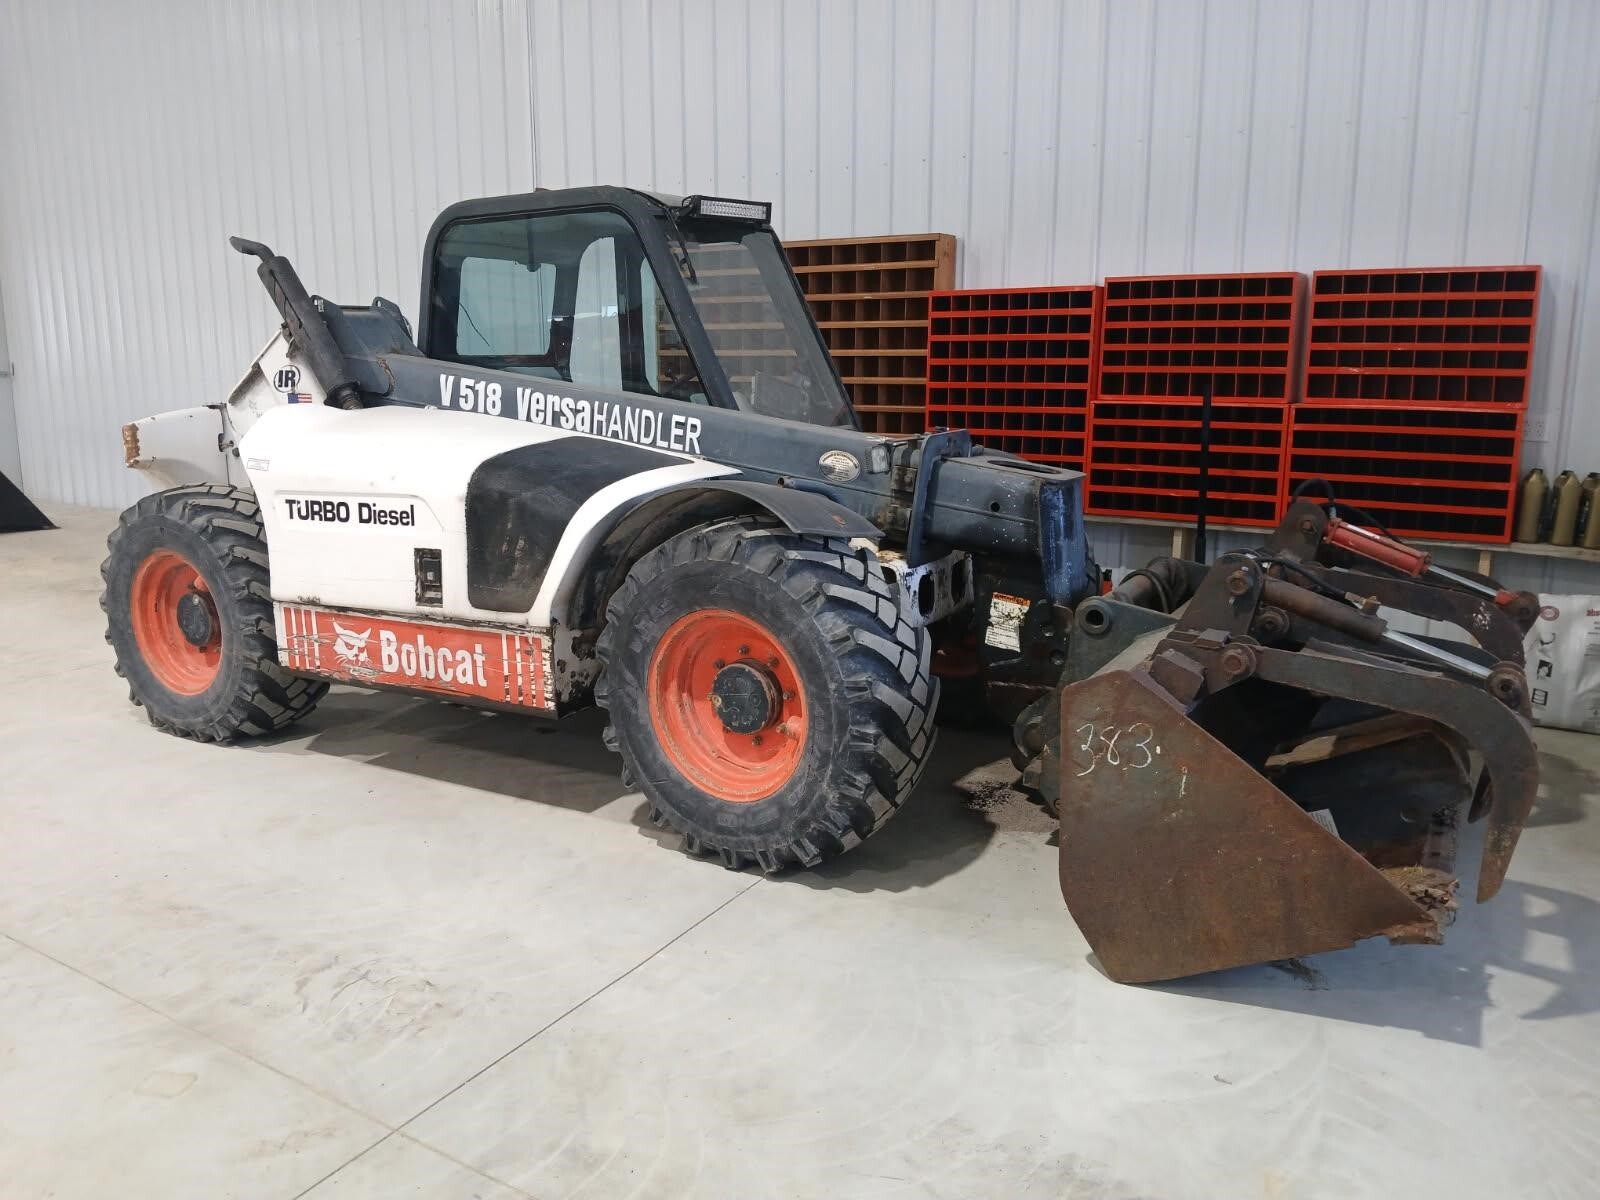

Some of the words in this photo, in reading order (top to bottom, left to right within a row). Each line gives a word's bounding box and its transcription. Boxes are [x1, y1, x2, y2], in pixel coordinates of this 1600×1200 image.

[439, 373, 454, 407] V
[459, 377, 502, 416] 518
[516, 386, 702, 454] VersaHANDLER
[285, 499, 350, 523] TURBO
[358, 502, 415, 526] Diesel
[379, 629, 488, 687] Bobcat
